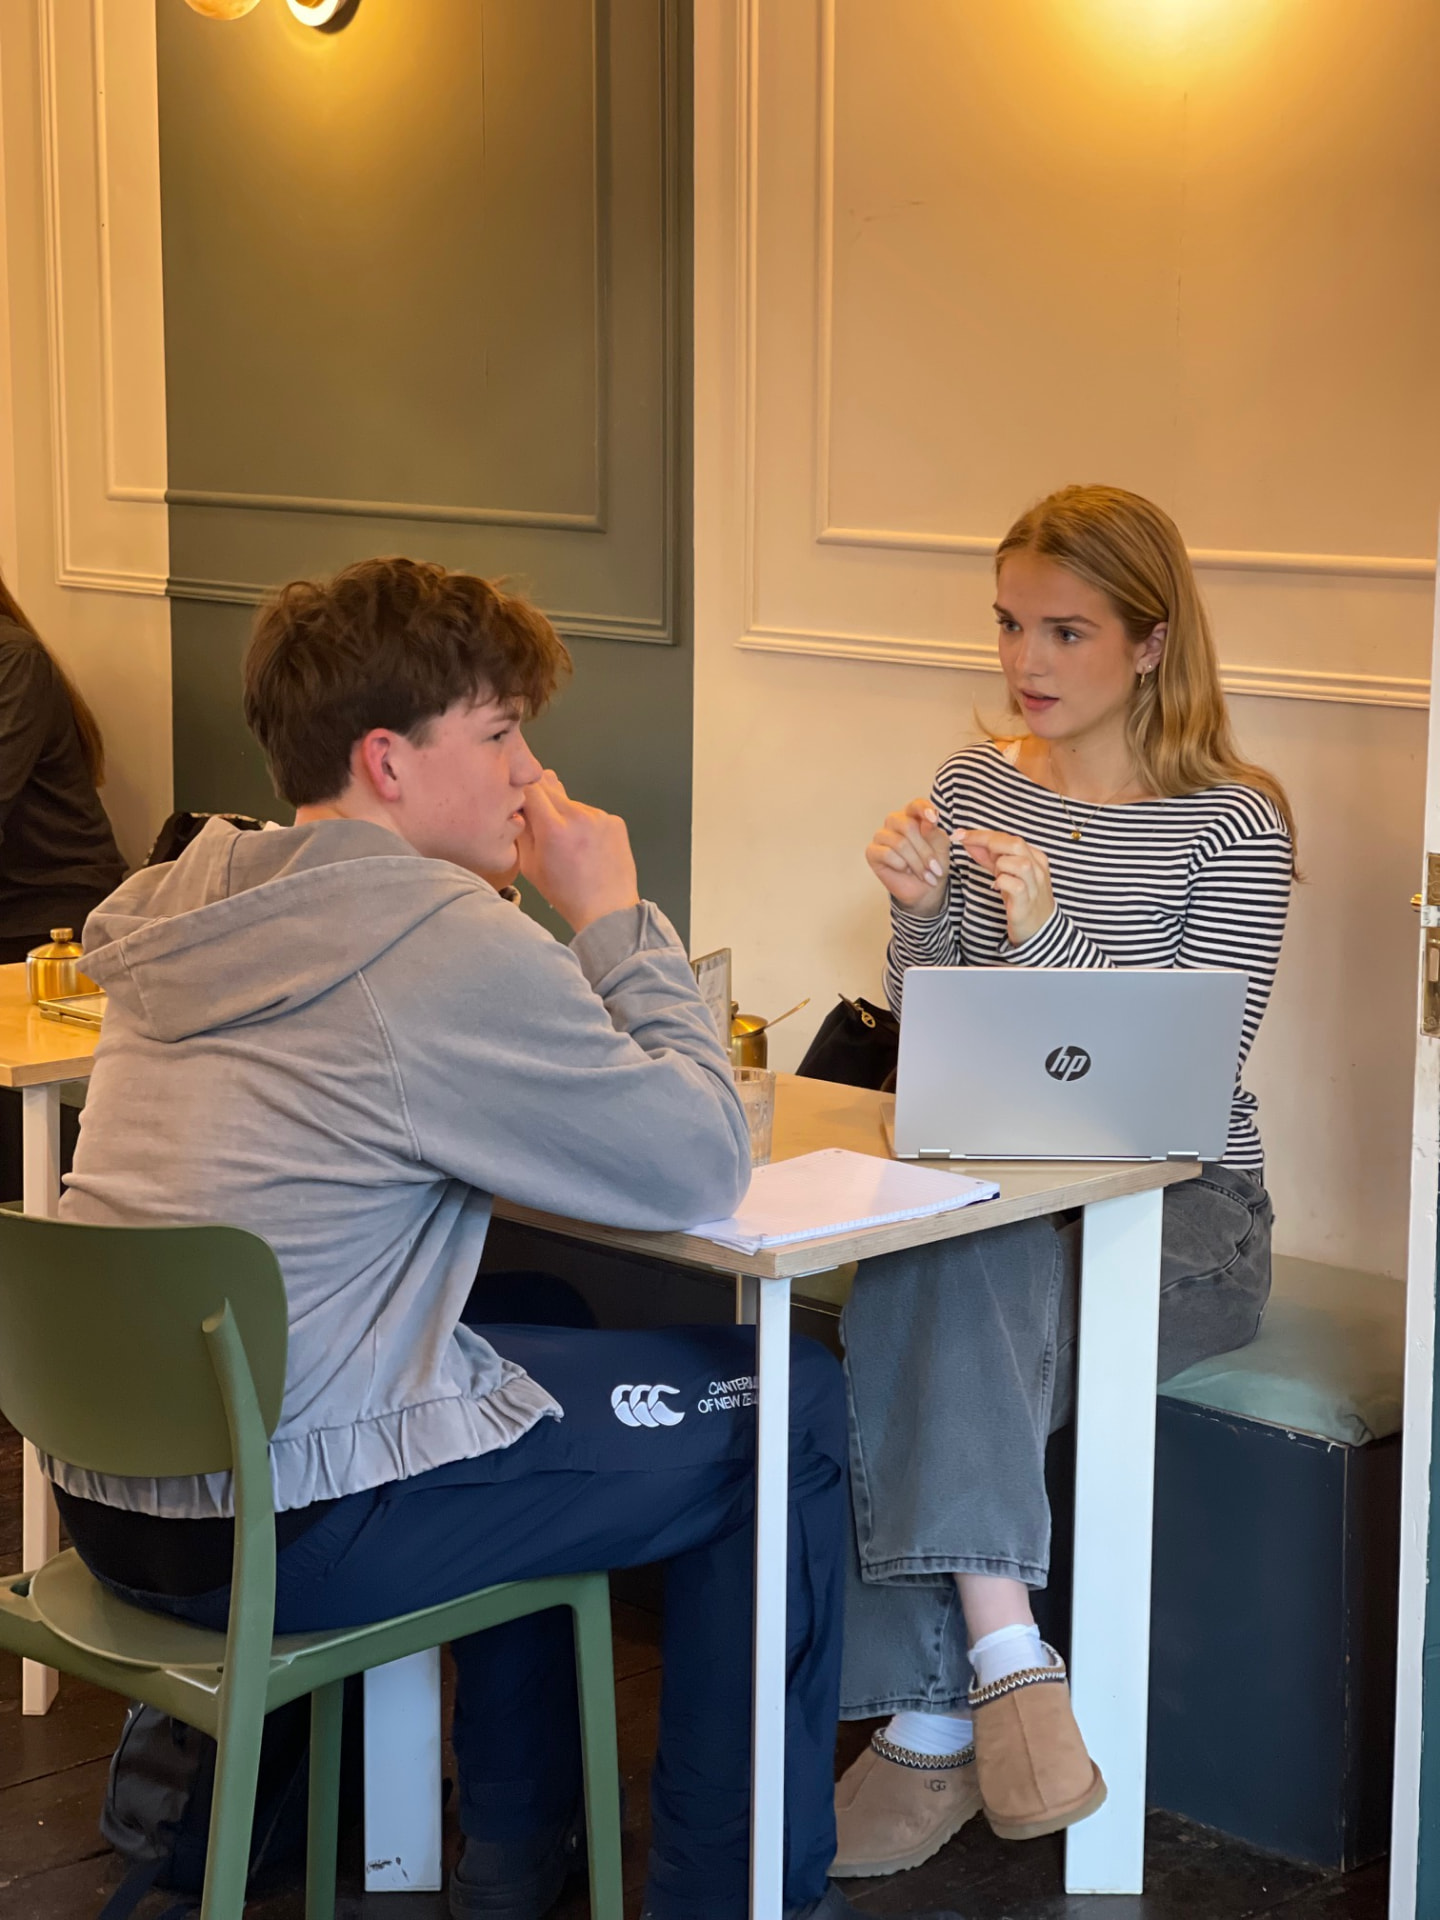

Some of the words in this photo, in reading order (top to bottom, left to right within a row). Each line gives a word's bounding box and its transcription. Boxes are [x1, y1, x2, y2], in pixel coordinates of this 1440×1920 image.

[1048, 1045, 1090, 1081] hp
[698, 1399, 713, 1413] OF
[714, 1394, 741, 1411] NEW
[924, 1779, 946, 1792] UGG
